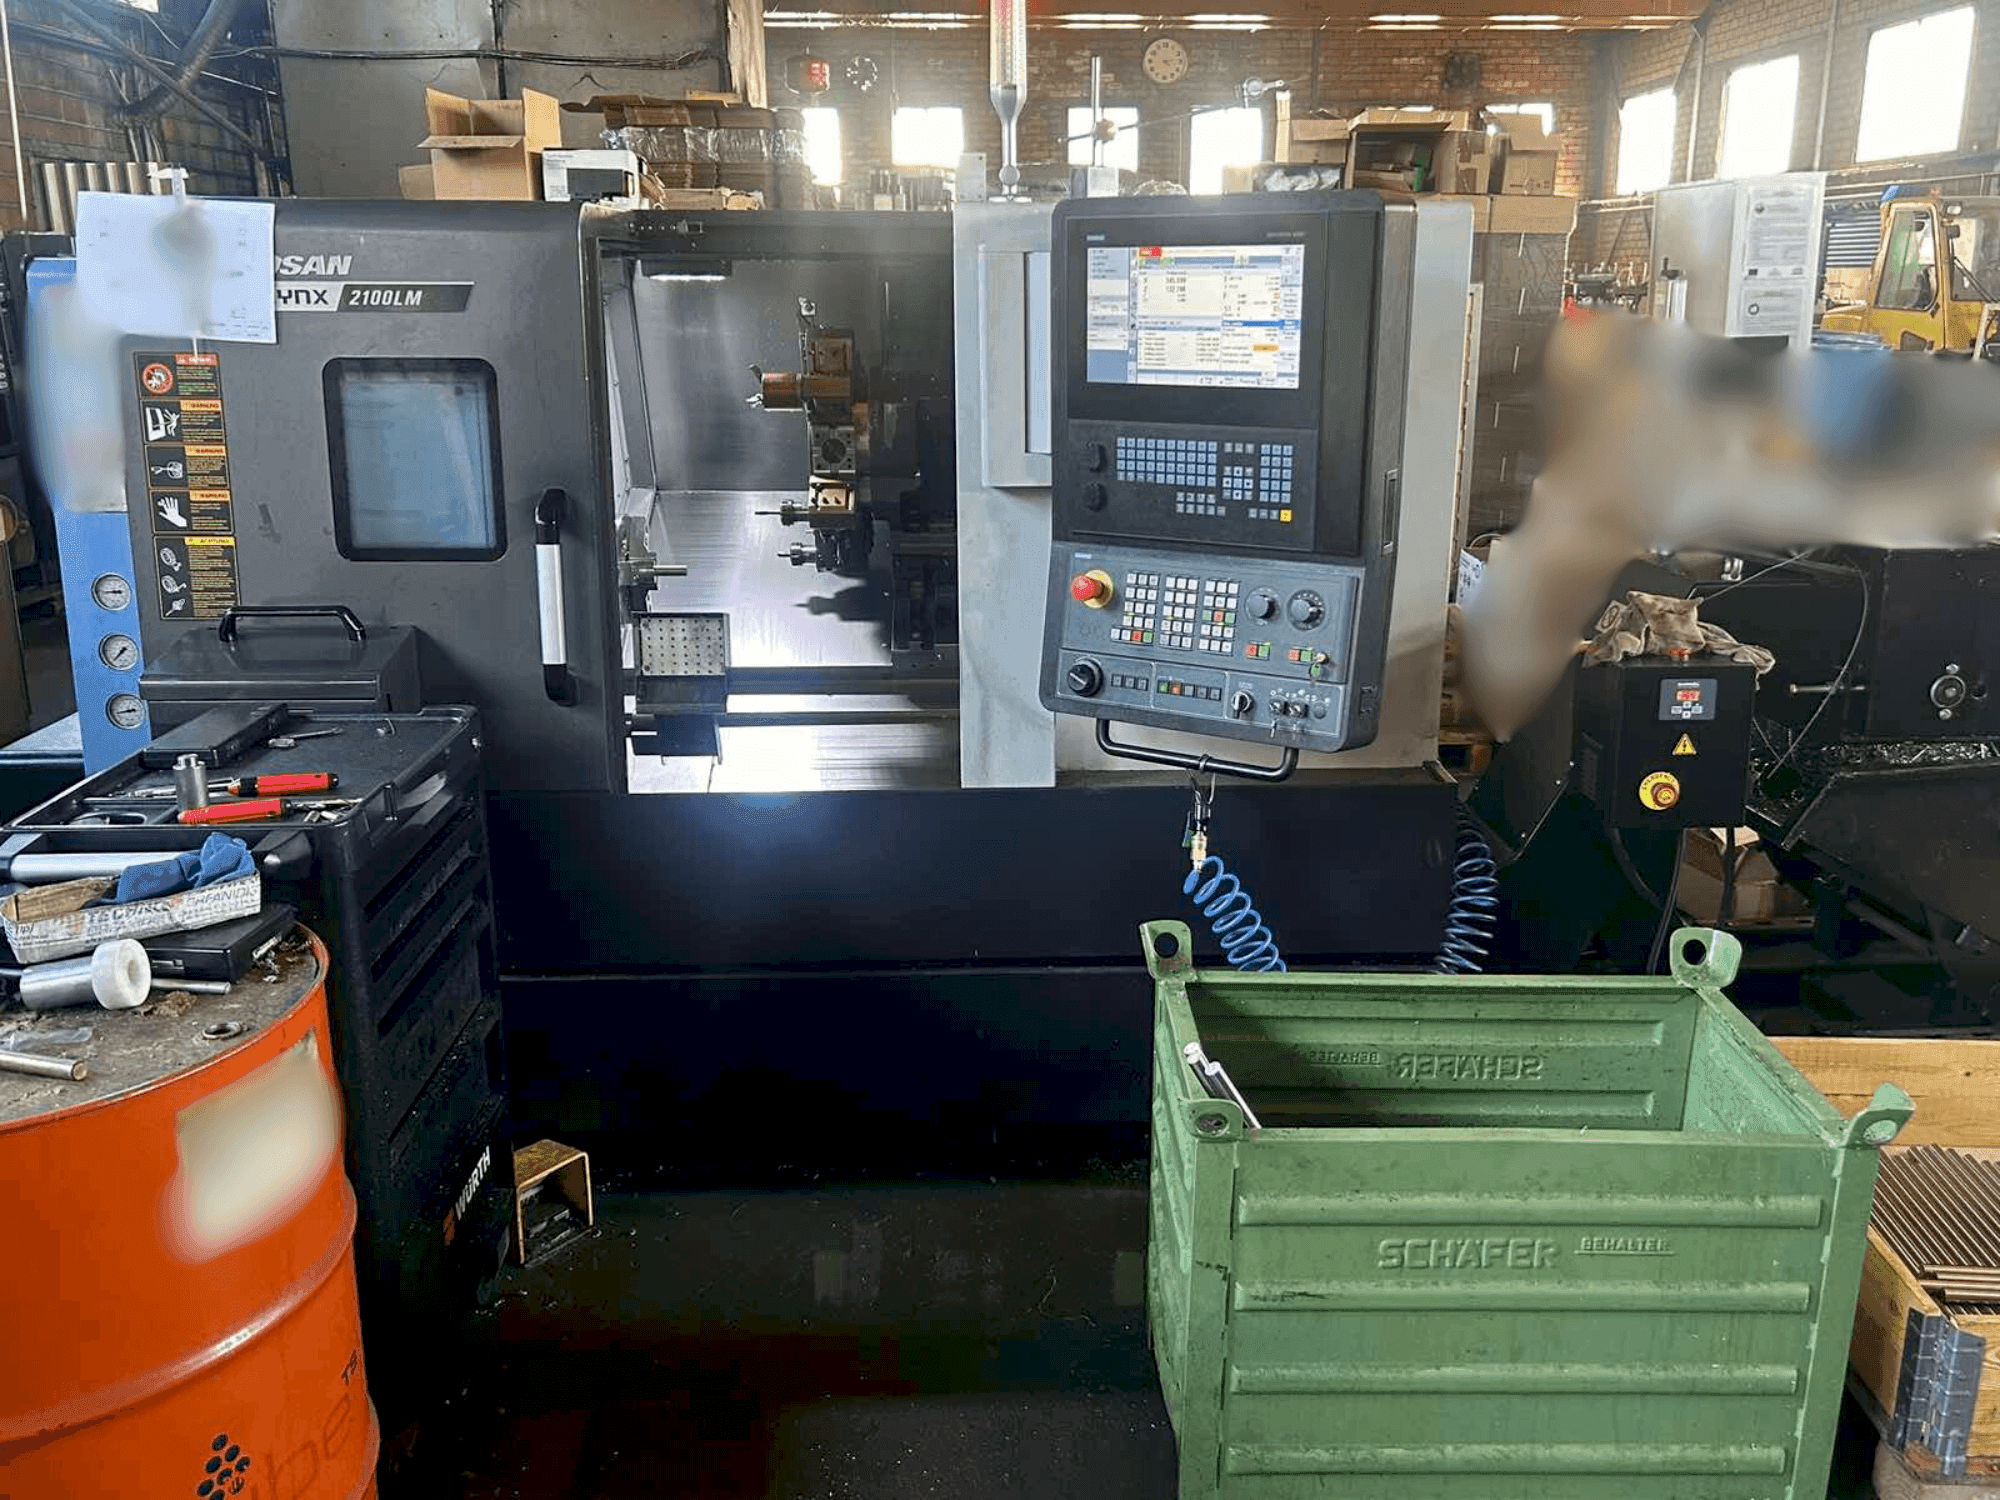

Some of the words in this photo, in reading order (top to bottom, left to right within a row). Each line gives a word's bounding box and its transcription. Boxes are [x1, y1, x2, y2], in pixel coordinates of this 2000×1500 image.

[349, 289, 424, 306] 2100LM
[455, 1145, 491, 1221] WÜRTH
[1379, 1238, 1558, 1269] SCHÄFER
